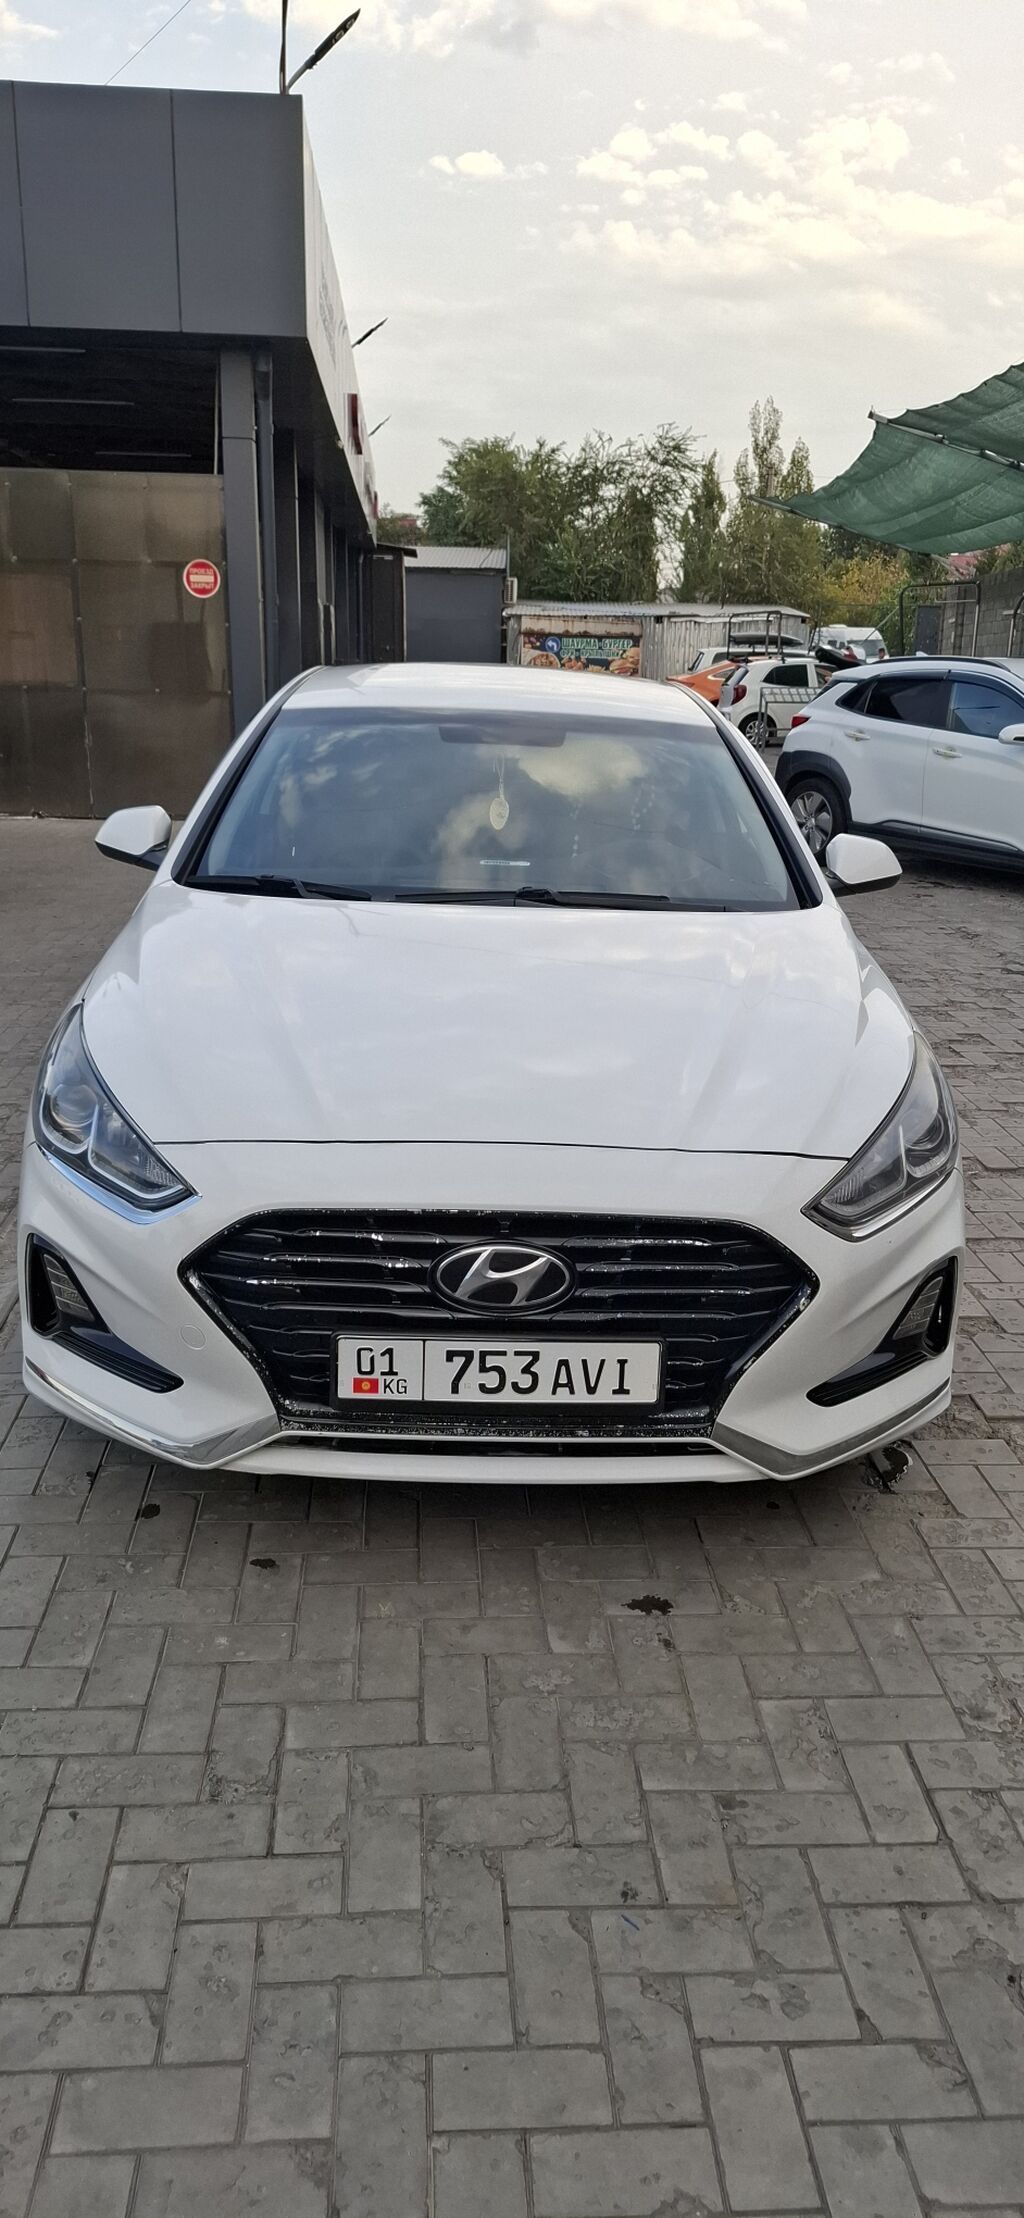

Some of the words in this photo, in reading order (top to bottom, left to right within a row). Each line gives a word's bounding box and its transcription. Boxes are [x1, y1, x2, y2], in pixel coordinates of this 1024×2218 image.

[561, 638, 598, 649] ШАУРМА
[601, 638, 633, 650] БУРГЕР
[355, 1346, 399, 1377] 01
[383, 1378, 408, 1395] KG
